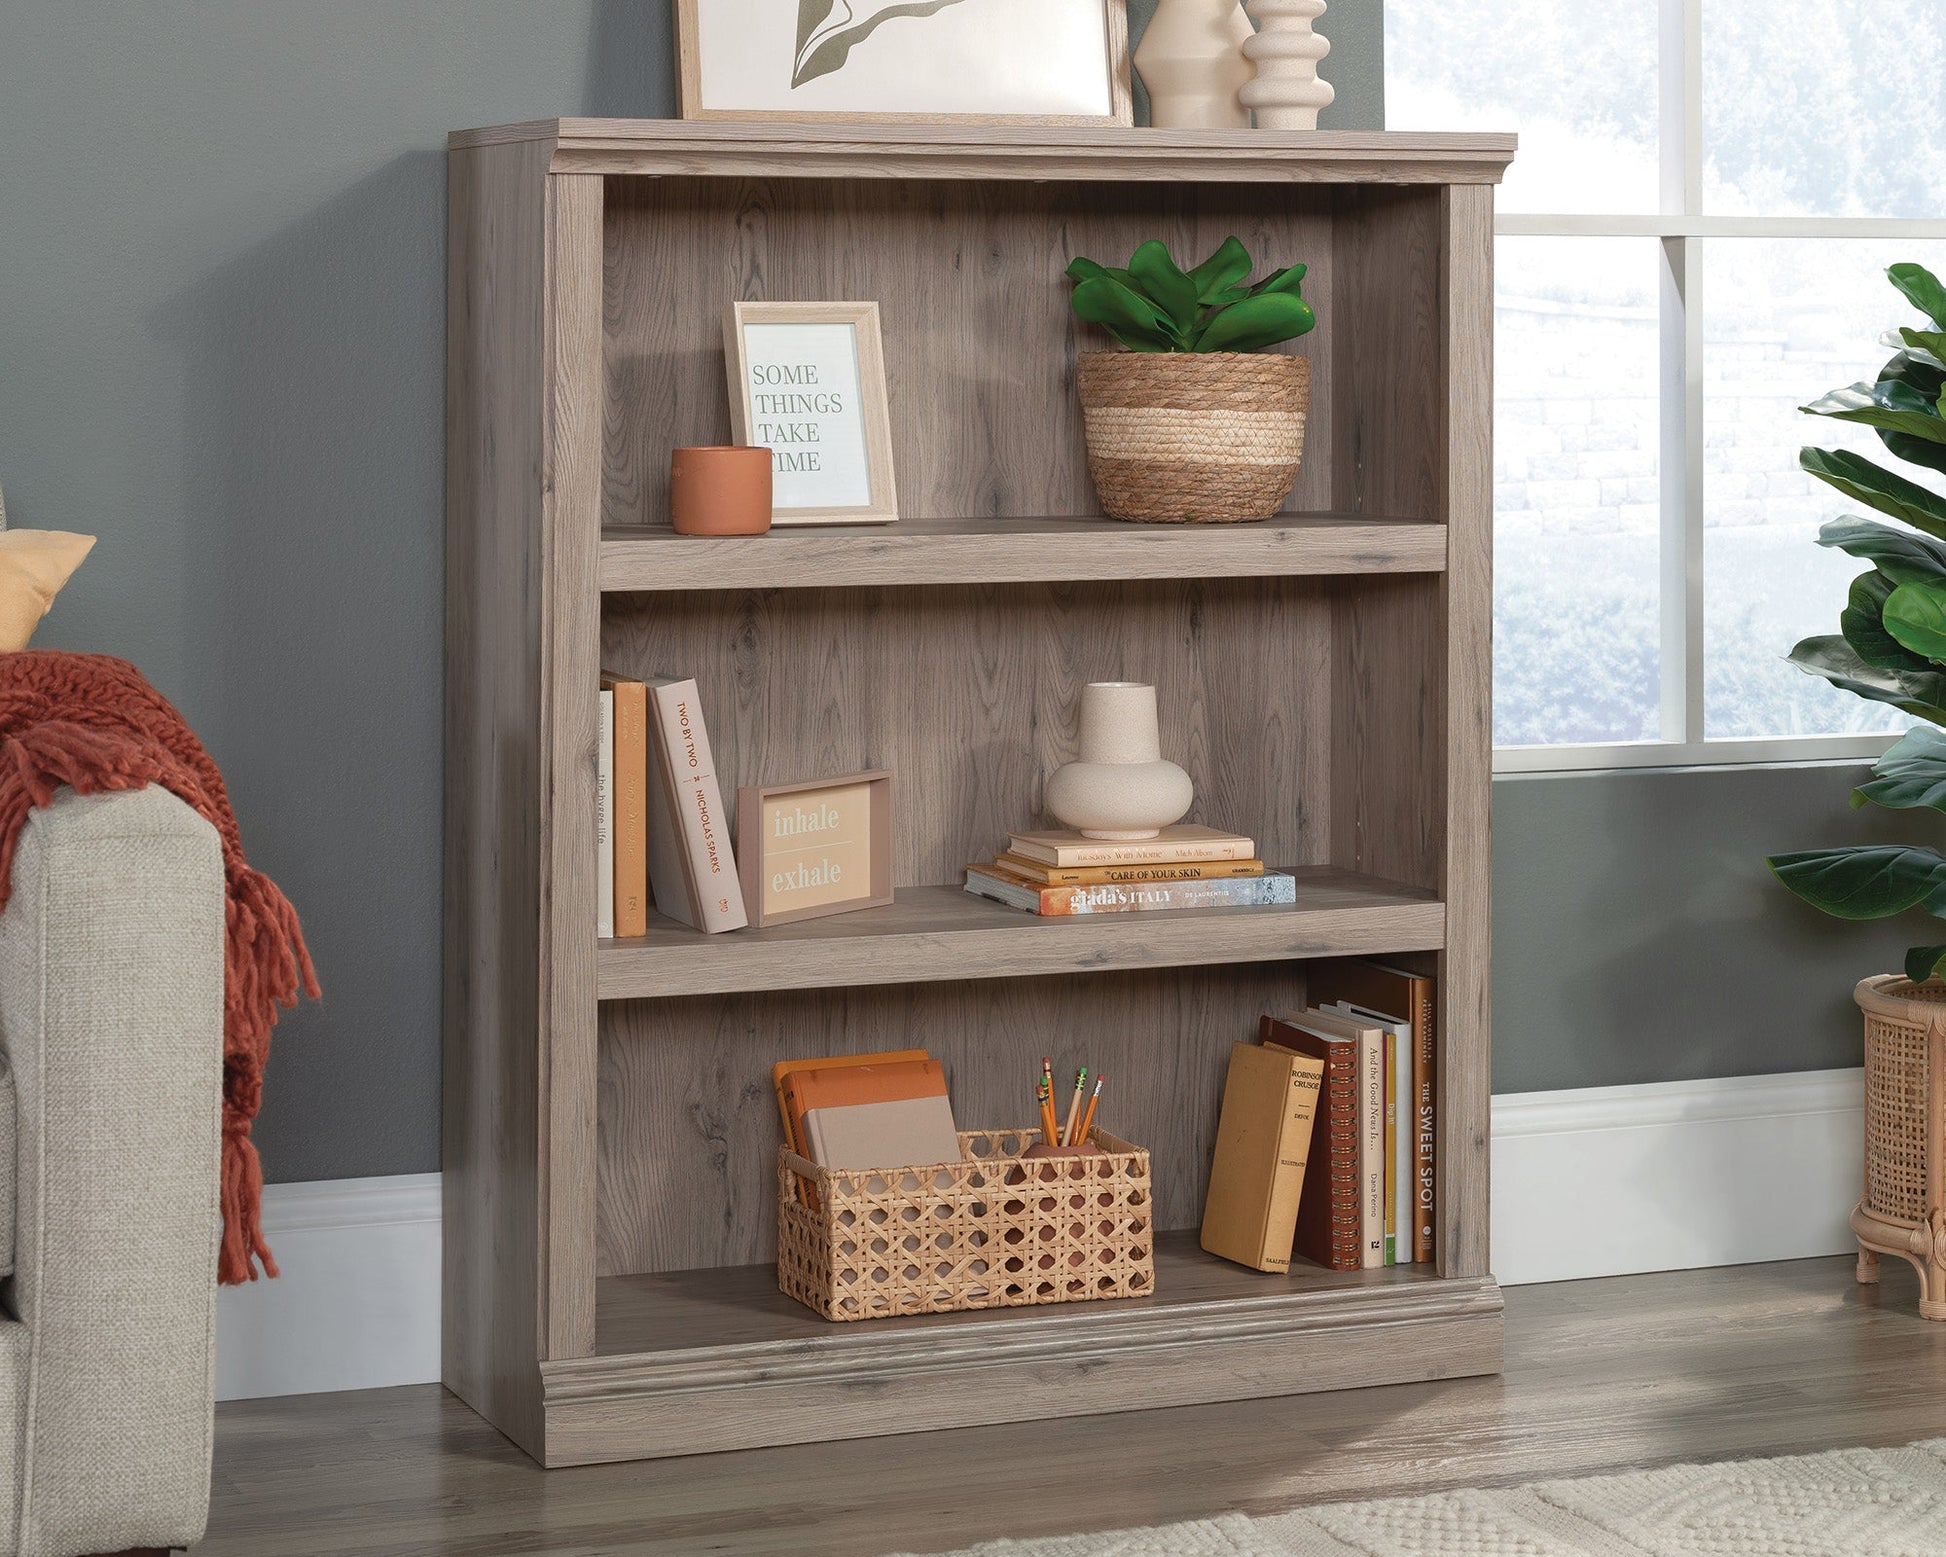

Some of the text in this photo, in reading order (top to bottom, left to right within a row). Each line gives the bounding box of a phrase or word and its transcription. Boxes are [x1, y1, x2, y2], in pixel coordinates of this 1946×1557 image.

[752, 364, 819, 385] SOME
[754, 392, 844, 414] THINGS
[758, 422, 821, 444] TAKE
[676, 701, 699, 769] TWO BY TWO
[598, 774, 606, 791] the
[773, 803, 841, 838] inhale
[597, 827, 607, 845] life
[695, 789, 721, 875] NICHOLAS SPARKS
[771, 858, 842, 893] exhale
[1110, 867, 1201, 881] CARE OF YOUR SKIN
[1069, 888, 1172, 911] giada's ITALY
[1369, 1047, 1379, 1066] And
[1293, 1079, 1320, 1090] CRUSOE
[1370, 1067, 1379, 1080] the
[1369, 1082, 1379, 1106] Good
[1369, 1107, 1380, 1130] News
[1420, 1081, 1433, 1212] THE SWEET SPOT
[1370, 1173, 1378, 1218] Dana Perino
